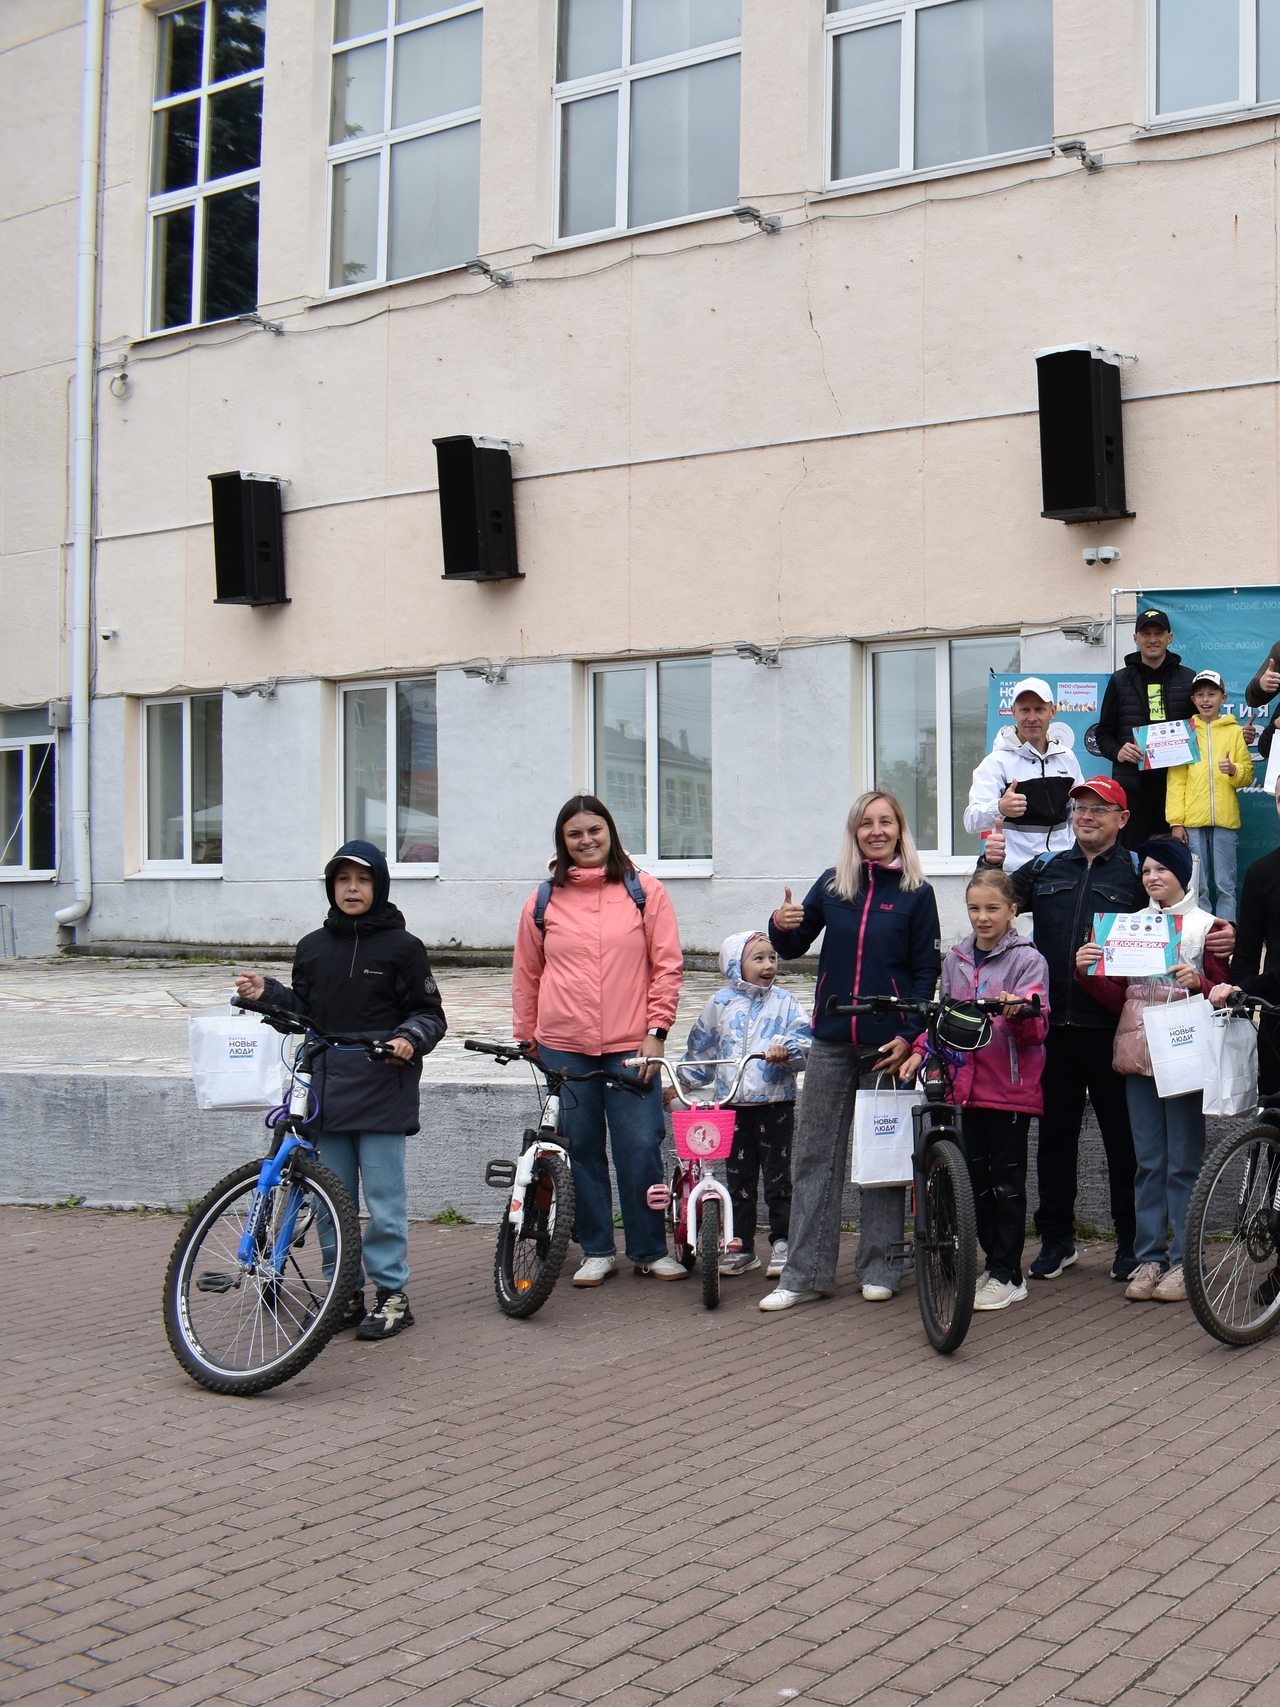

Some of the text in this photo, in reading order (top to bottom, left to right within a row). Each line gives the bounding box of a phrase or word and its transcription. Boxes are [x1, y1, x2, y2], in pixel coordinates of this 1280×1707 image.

[1184, 603, 1212, 612] ЛЮДИ
[1226, 602, 1260, 610] НОВЫЕ
[1201, 641, 1264, 650] НОВЫЕ ЛЮДИ
[1169, 1026, 1196, 1037] НОВЫЕ
[1171, 1034, 1193, 1043] ЛЮДИ
